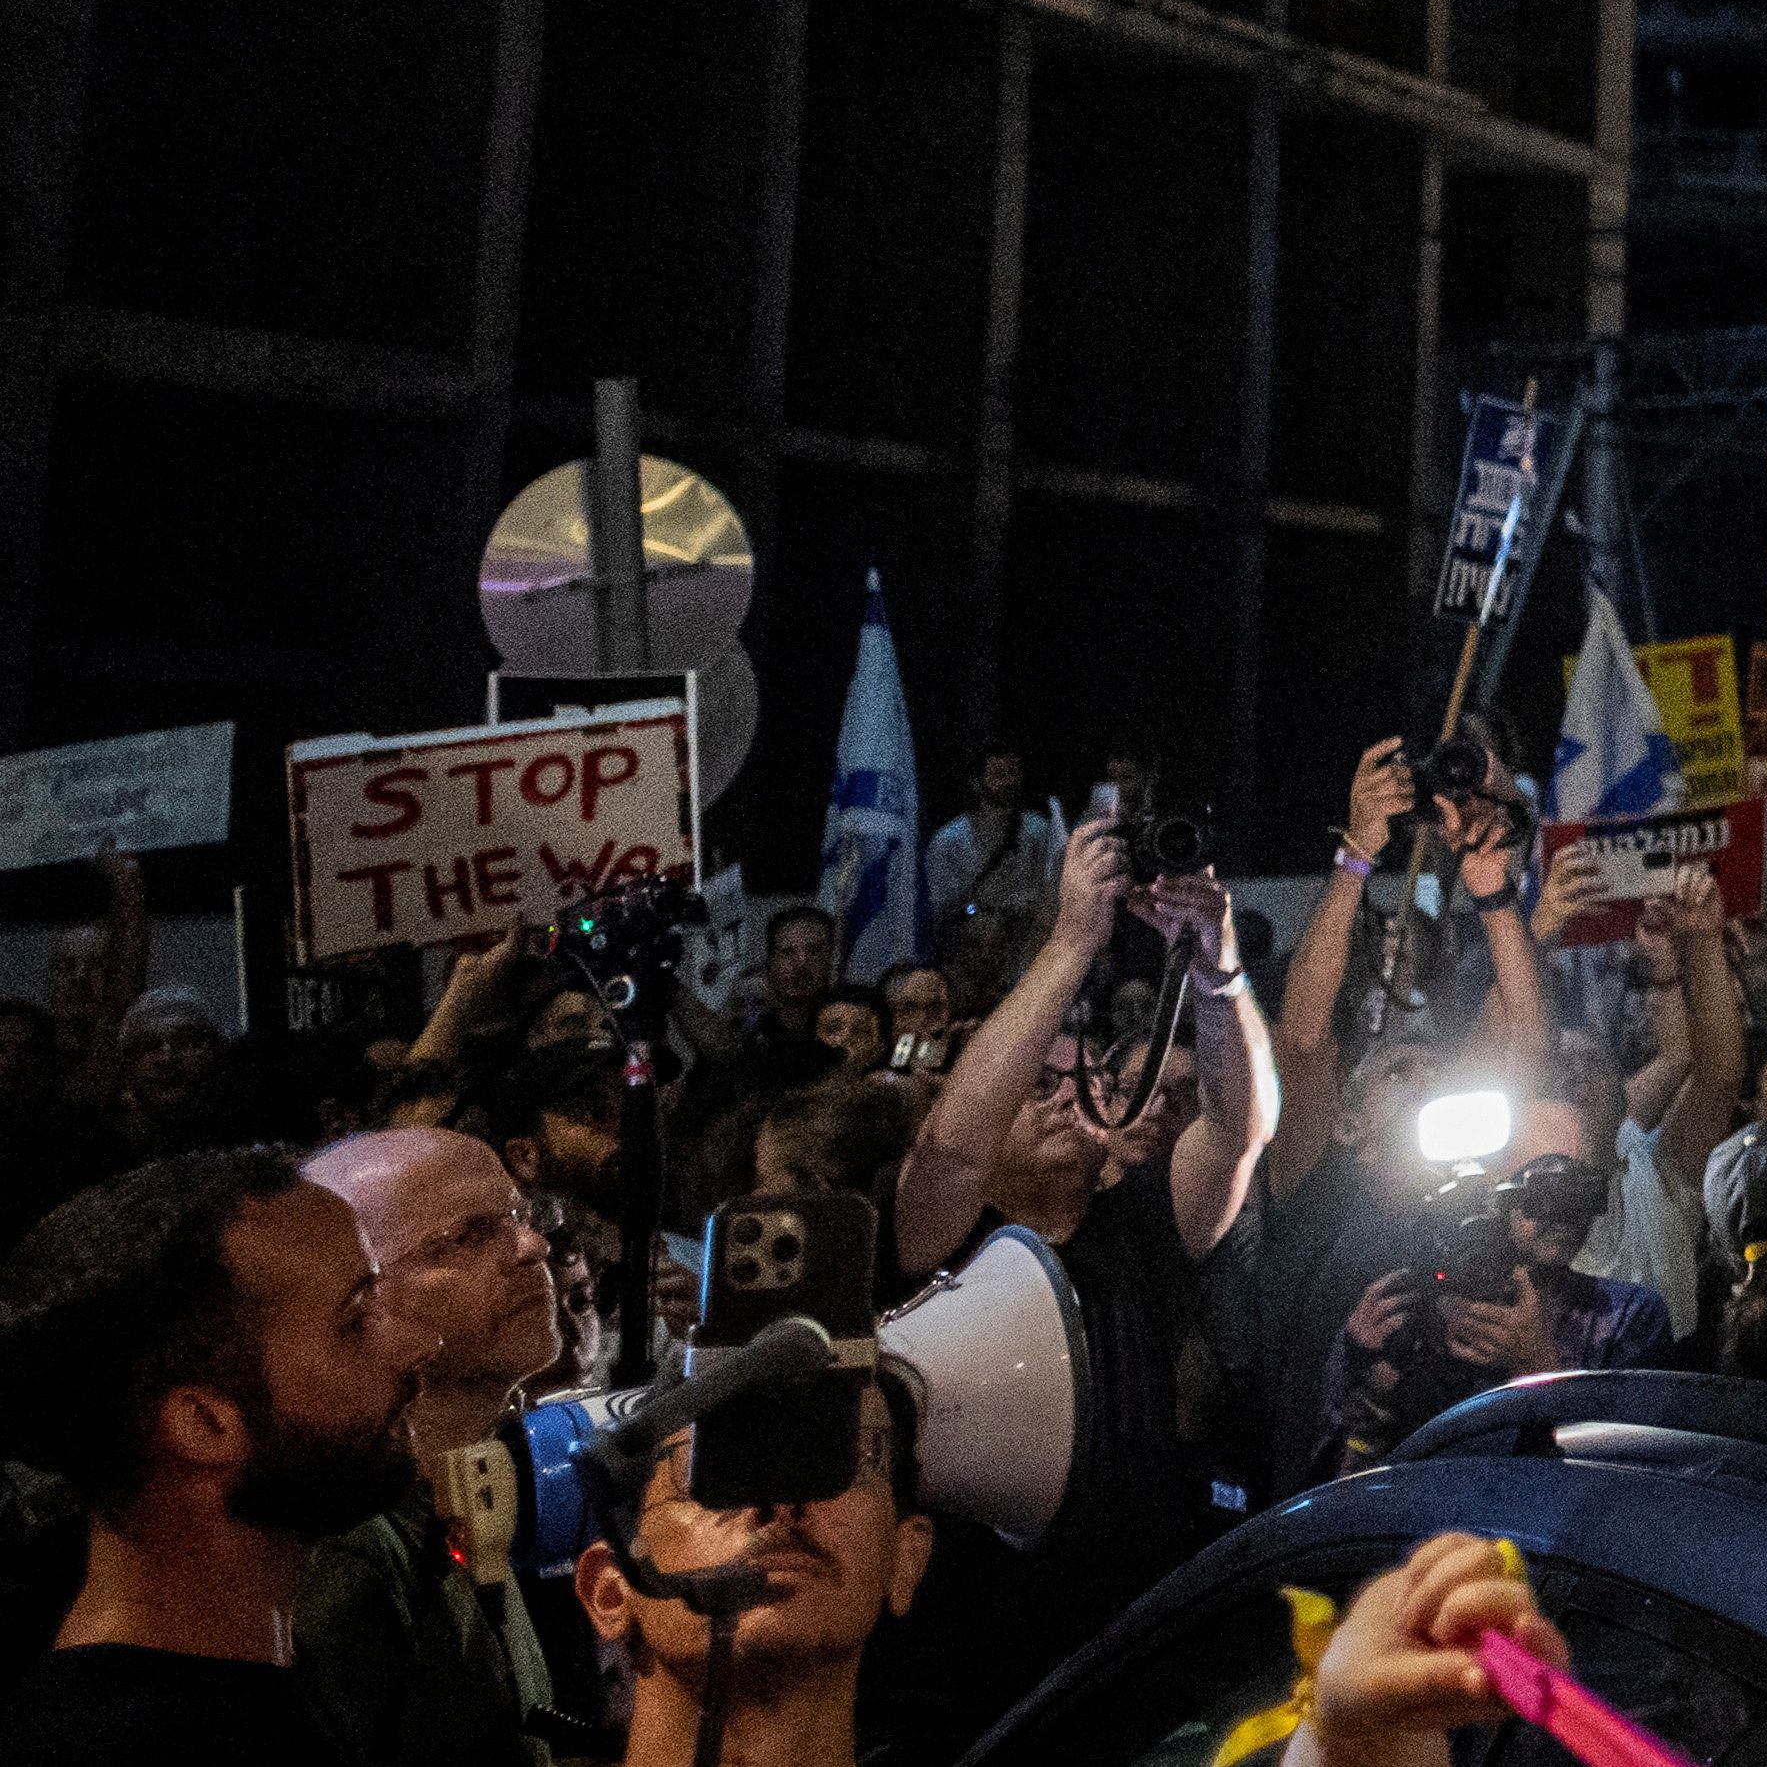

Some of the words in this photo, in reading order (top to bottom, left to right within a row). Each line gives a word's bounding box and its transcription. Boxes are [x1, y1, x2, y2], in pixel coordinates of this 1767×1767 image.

[350, 745, 640, 839] STOP
[337, 844, 521, 933] THE
[539, 840, 668, 898] WA
